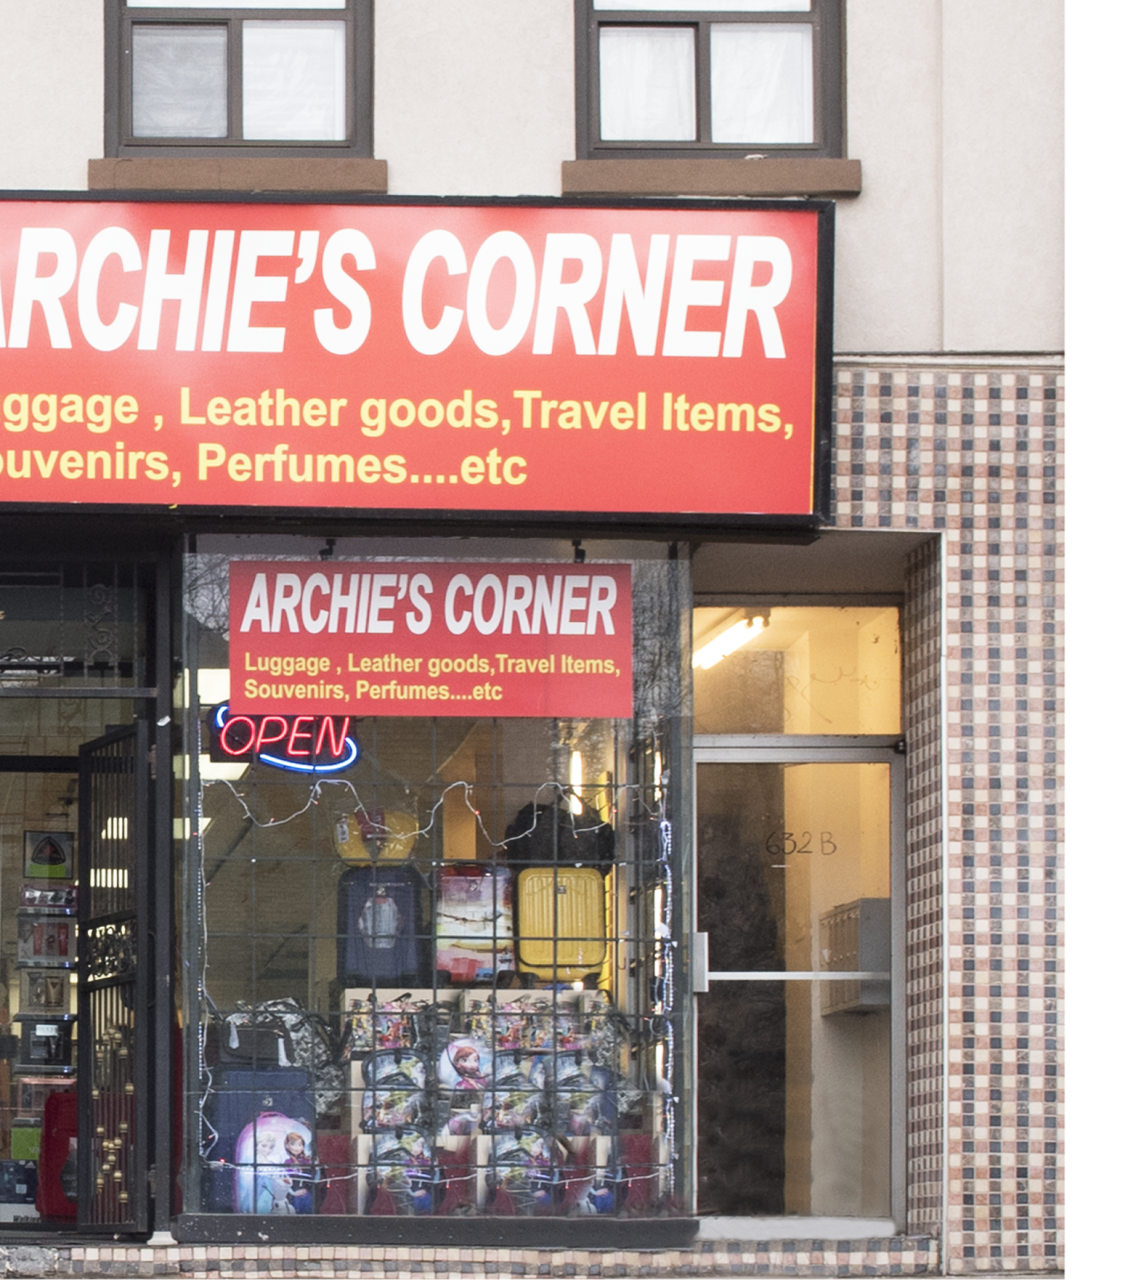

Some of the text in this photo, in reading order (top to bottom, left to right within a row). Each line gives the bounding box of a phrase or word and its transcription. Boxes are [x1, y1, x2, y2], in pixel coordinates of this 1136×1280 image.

[402, 229, 793, 359] CORNER
[180, 387, 347, 427] Leather
[663, 392, 794, 439] Items,
[239, 572, 618, 636] ARCHIE'S CORNER
[347, 653, 423, 673] Leather
[561, 655, 621, 677] Items,
[244, 678, 350, 703] Souvenirs,
[220, 716, 350, 756] OPEN
[766, 831, 813, 855] 632
